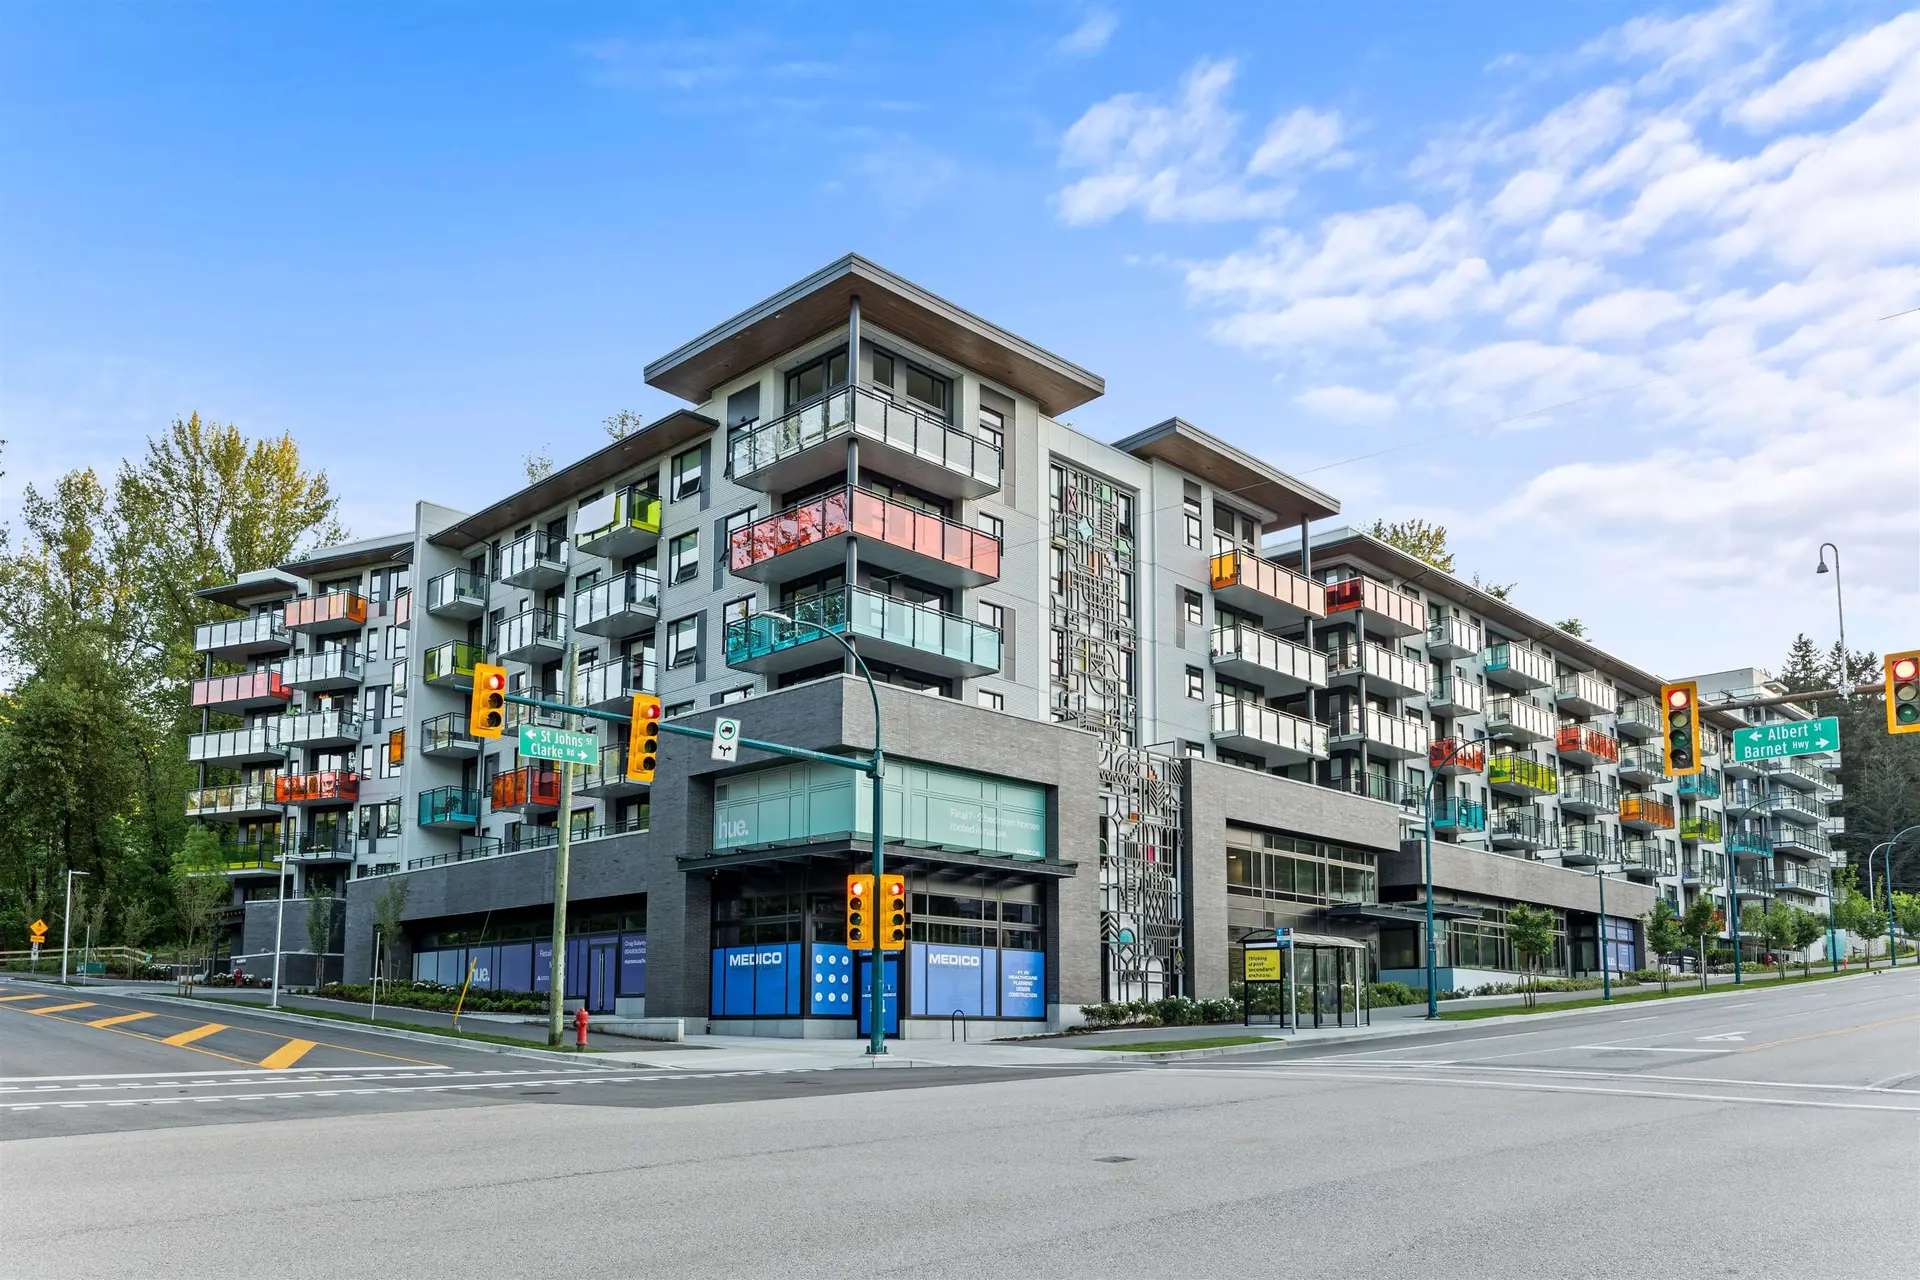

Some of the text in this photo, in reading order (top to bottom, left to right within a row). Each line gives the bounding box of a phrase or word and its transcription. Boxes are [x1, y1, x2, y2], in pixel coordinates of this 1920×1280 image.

[541, 731, 550, 743] St
[554, 732, 582, 747] Johns
[1768, 723, 1821, 740] Albert St
[531, 743, 574, 758] Clarke Rd
[1745, 741, 1809, 758] Barnet Hwy
[719, 815, 748, 839] hue.
[1017, 819, 1040, 832] homes
[730, 952, 782, 967] MEDICO
[929, 953, 980, 967] MEDICO
